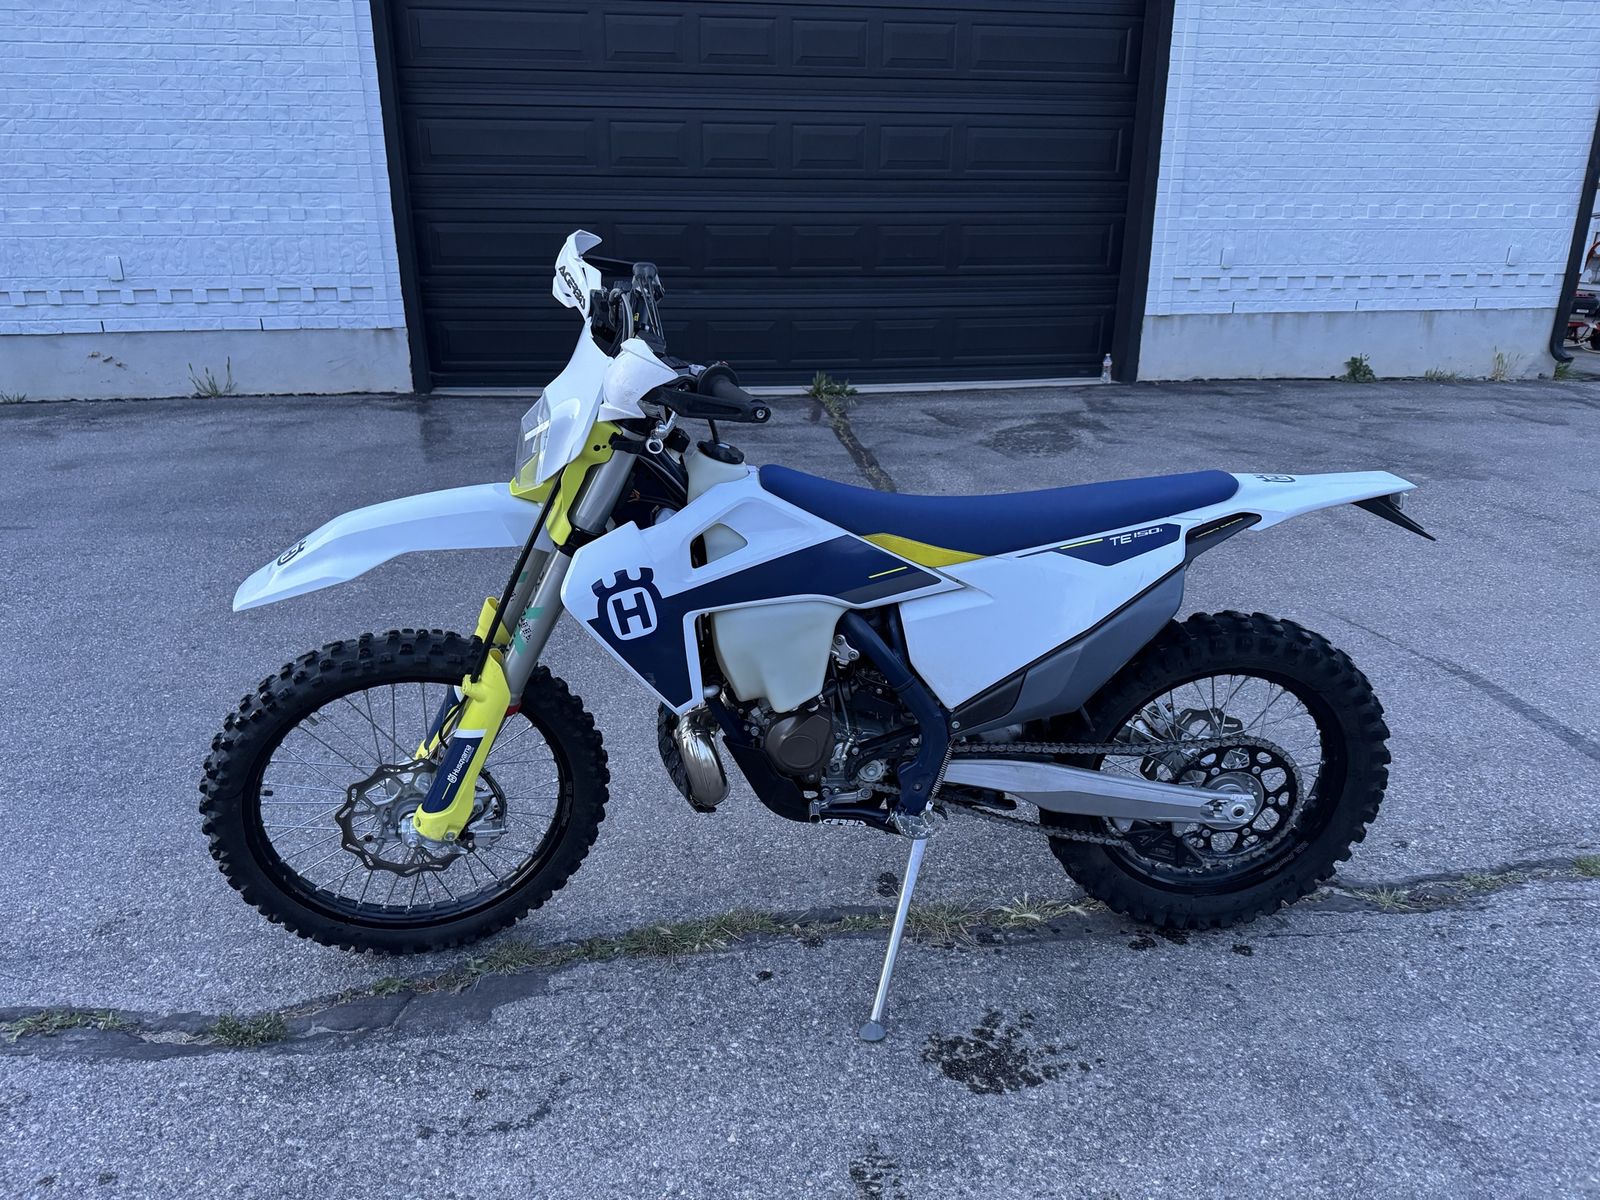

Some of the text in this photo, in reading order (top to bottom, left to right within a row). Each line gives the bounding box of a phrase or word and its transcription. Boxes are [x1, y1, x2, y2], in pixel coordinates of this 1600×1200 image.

[1109, 533, 1133, 546] TE
[612, 591, 653, 636] H
[451, 744, 472, 777] Husqvarna
